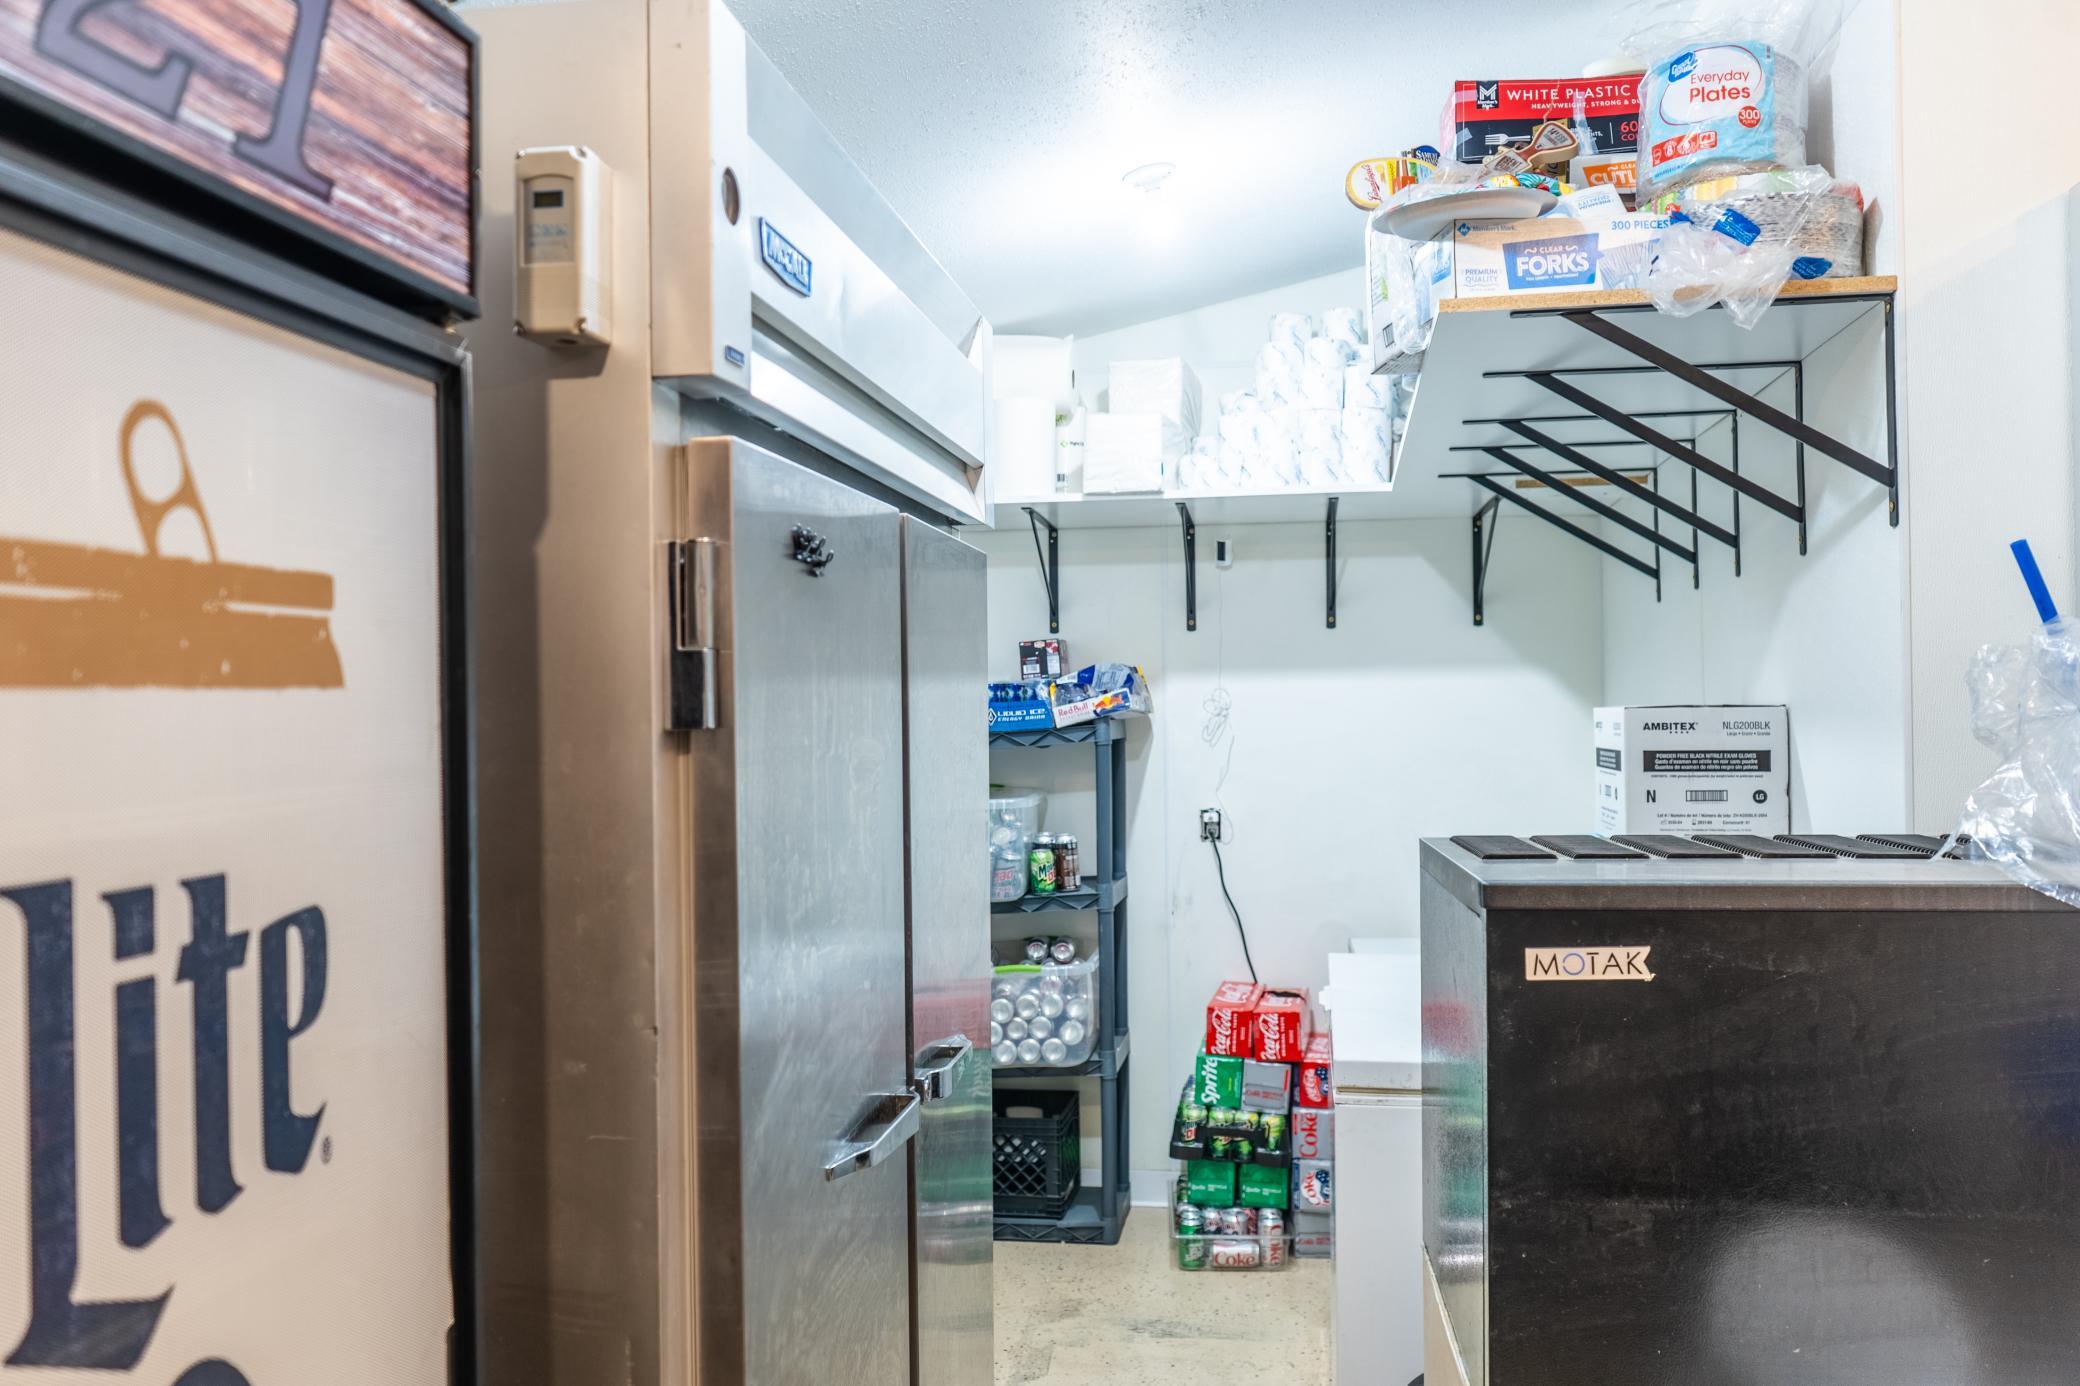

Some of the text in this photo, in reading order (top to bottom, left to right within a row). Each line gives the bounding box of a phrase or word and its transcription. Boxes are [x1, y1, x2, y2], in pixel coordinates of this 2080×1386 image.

[1690, 70, 1750, 84] Everyday
[1506, 84, 1632, 101] WHITE PLASTIC
[1690, 85, 1751, 104] Plates
[1591, 100, 1622, 108] STRONG
[1739, 109, 1760, 119] 300
[1590, 171, 1636, 185] CUTL
[1611, 219, 1669, 230] 300 PIECES
[1539, 246, 1563, 255] CLEAR
[1516, 252, 1590, 277] FORKS
[1465, 268, 1498, 276] PREMIUM
[1465, 276, 1499, 284] QUALITY
[997, 708, 1027, 717] LIQUID
[1643, 722, 1696, 731] AMBITEX
[1722, 721, 1771, 730] NLG200BLK
[1646, 789, 1657, 803] N
[1533, 951, 1643, 976] MOTAK
[1201, 1057, 1221, 1105] Sprite
[0, 871, 328, 1372] Lite
[1299, 1110, 1318, 1159] Coke
[1213, 1252, 1256, 1267] Coke
